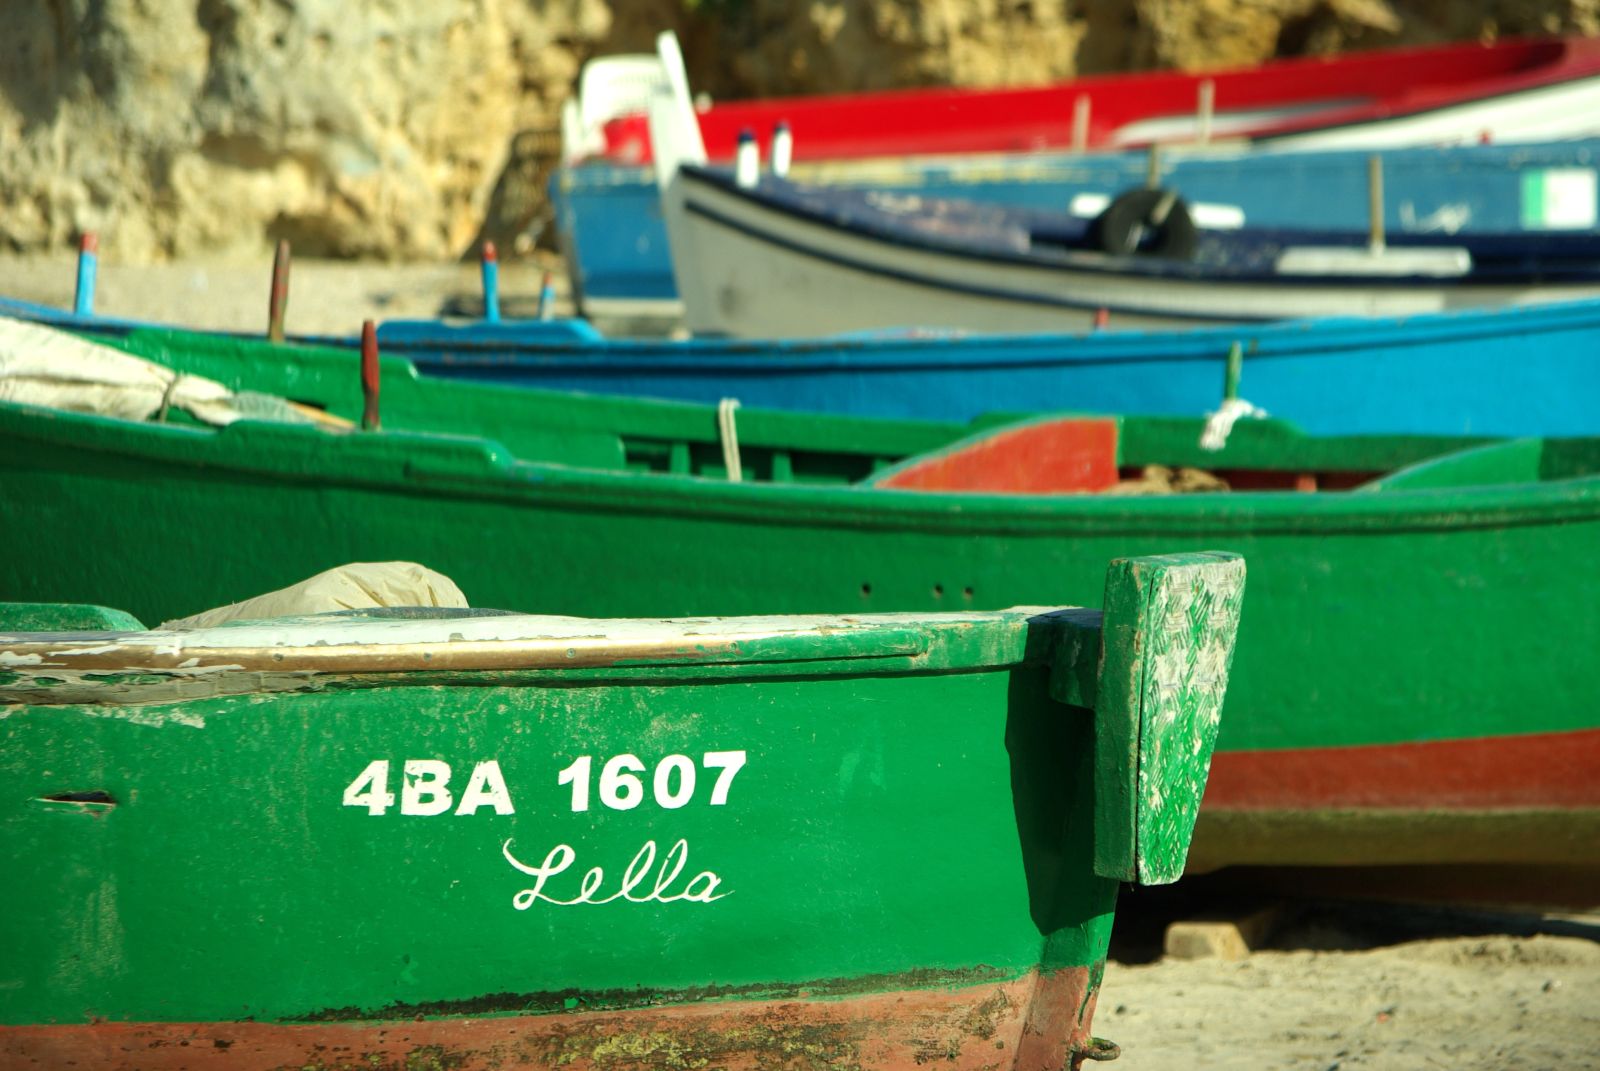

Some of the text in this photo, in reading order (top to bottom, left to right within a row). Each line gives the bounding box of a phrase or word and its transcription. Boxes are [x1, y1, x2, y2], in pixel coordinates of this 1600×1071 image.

[343, 751, 747, 816] 4BA 1607
[502, 838, 735, 911] Lella
